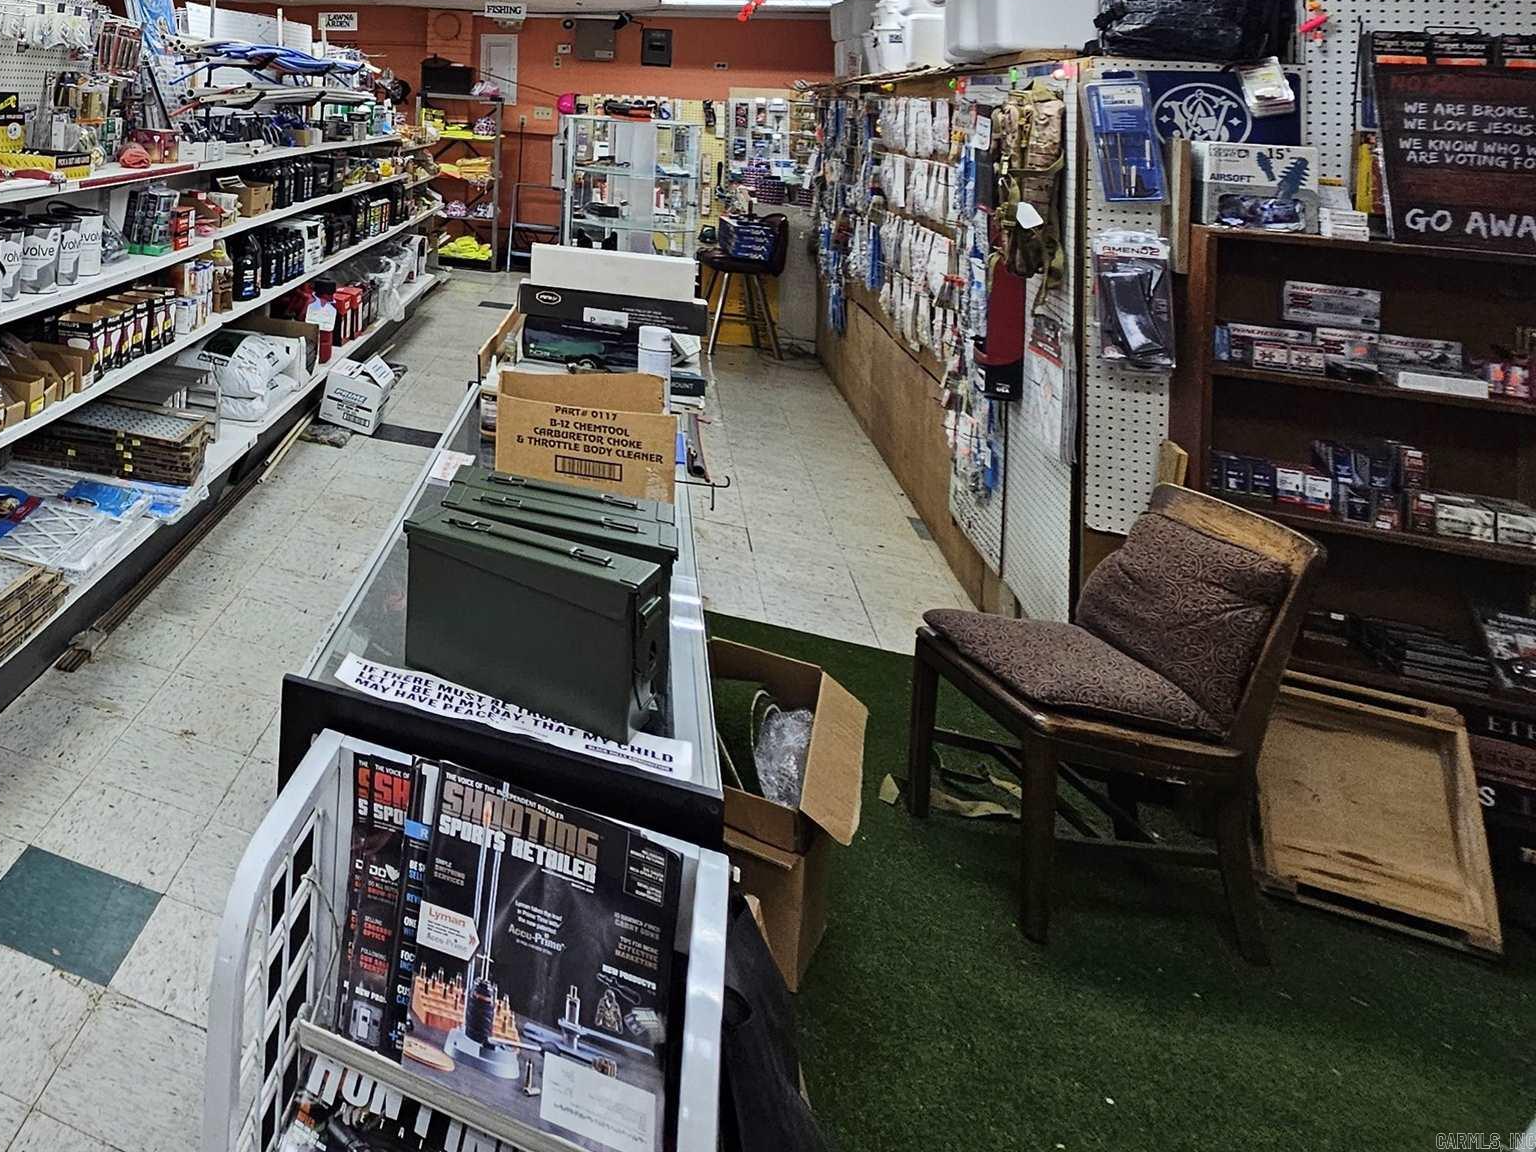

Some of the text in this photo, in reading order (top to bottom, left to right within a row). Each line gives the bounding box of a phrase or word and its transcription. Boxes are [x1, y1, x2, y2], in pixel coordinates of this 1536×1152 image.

[486, 5, 522, 16] FISHING
[1403, 101, 1429, 114] WE
[1433, 102, 1466, 117] ARE
[1403, 117, 1480, 133] WE LOVE
[1398, 137, 1521, 156] WE KNOW WHO
[1406, 150, 1440, 165] ARE
[1443, 153, 1510, 169] VOTING
[1209, 172, 1252, 183] AIRSOFT
[1404, 207, 1454, 233] GO
[22, 240, 56, 258] volve
[554, 404, 618, 421] PART# 0117
[533, 426, 644, 450] CARBURETOR CHOKE
[549, 417, 631, 438] B-12 CHEMTOOL
[527, 436, 581, 453] THROTTLE
[583, 444, 614, 458] BODY
[615, 448, 664, 465] CLEANER
[353, 676, 389, 695] MAY
[393, 688, 438, 709] HAVE
[382, 666, 435, 689] THERE
[437, 682, 487, 703] MUST
[357, 669, 388, 685] LET
[390, 678, 407, 690] IT
[411, 683, 433, 698] BE
[436, 691, 455, 703] IN
[457, 697, 488, 713] MY
[531, 717, 578, 738] THAT
[617, 742, 675, 764] CHILD
[441, 779, 601, 866] SHOOTING
[438, 813, 507, 853] SPORTS
[510, 836, 597, 886] RETAILER
[428, 905, 468, 928] Lyman
